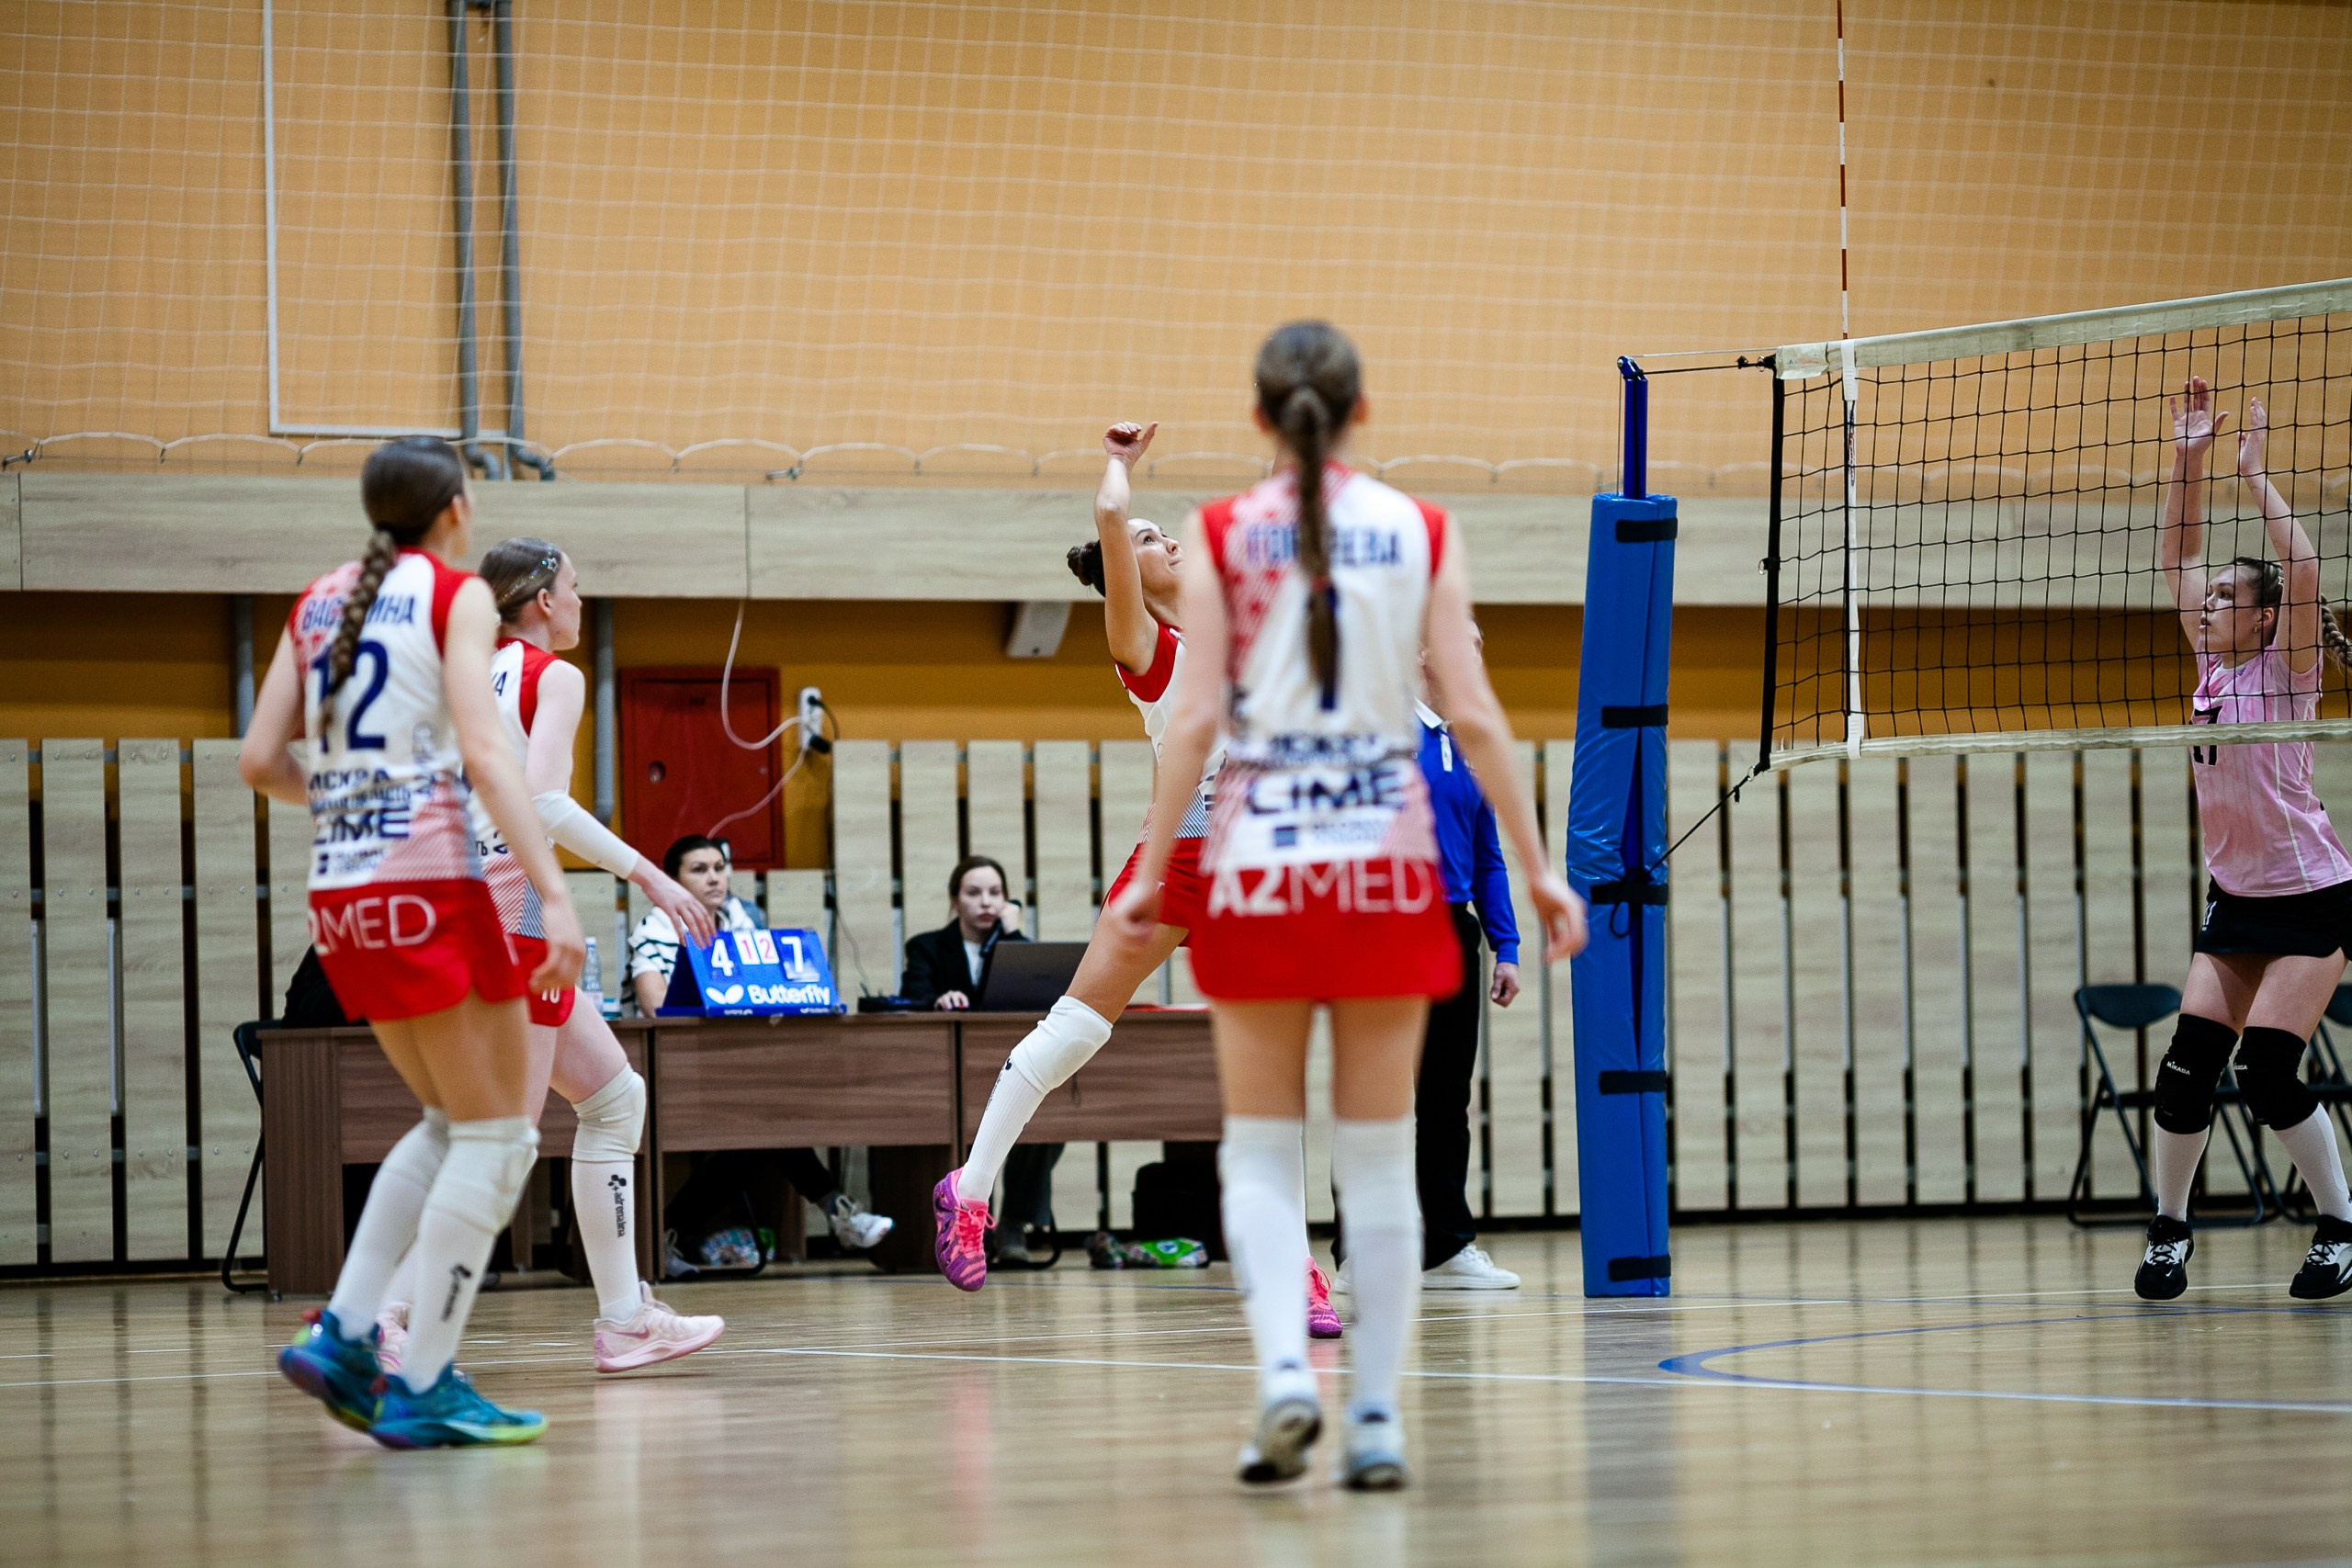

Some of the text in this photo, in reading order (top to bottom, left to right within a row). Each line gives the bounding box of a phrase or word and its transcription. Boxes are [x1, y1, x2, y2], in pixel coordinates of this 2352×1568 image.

[311, 639, 389, 753] 12
[711, 938, 734, 976] 4
[781, 935, 805, 974] 7
[747, 984, 831, 1006] Butterfly
